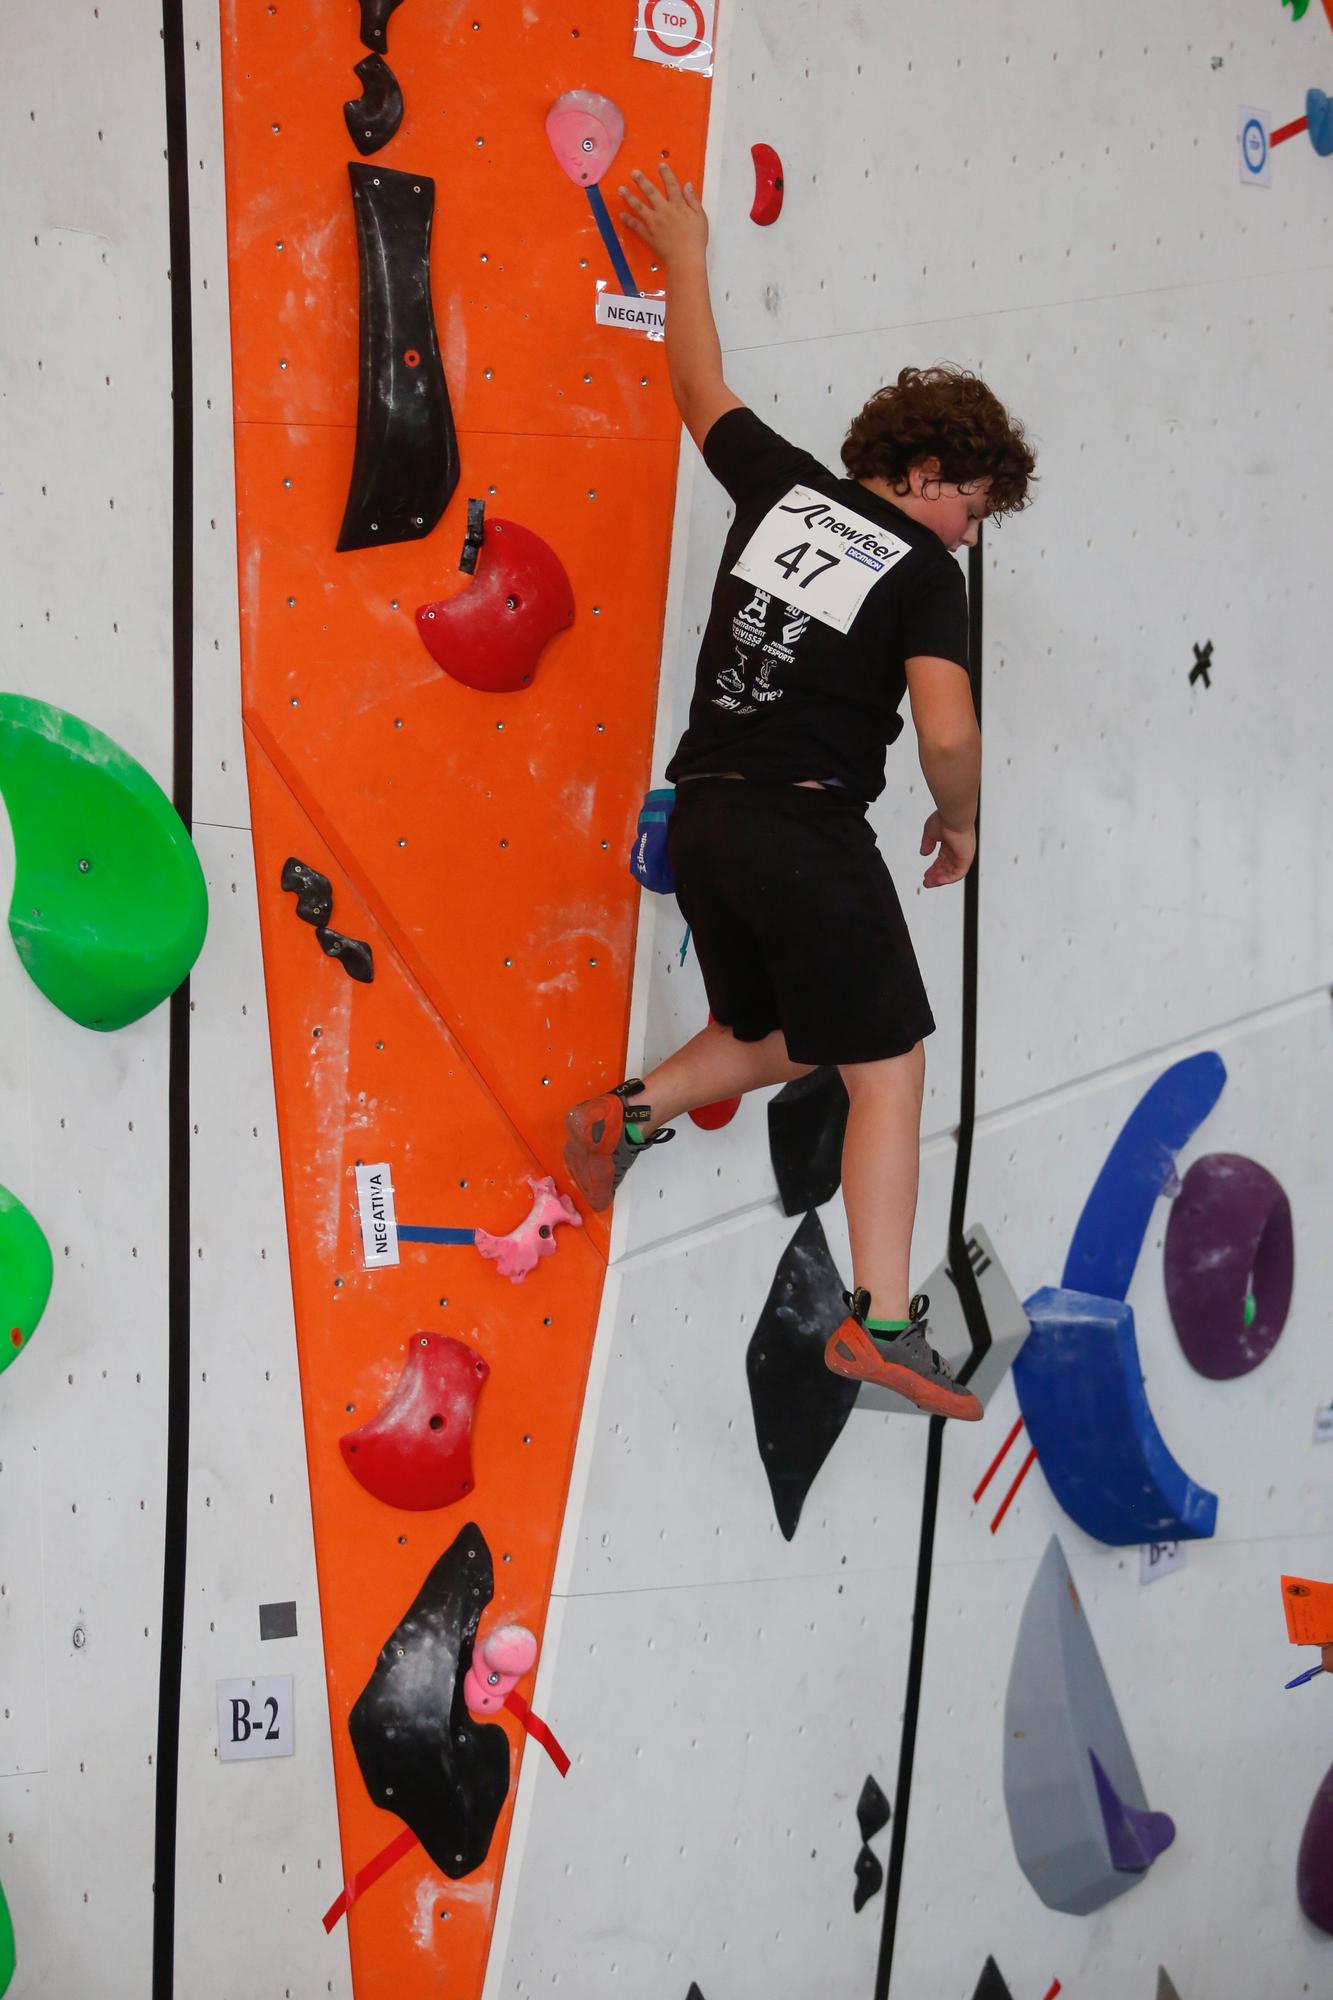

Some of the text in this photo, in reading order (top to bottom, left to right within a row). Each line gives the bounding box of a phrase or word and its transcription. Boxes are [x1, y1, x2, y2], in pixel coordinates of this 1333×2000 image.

[662, 12, 687, 28] TOP
[607, 306, 665, 327] NEGATIV
[817, 515, 900, 561] newfeel
[774, 541, 841, 589] 47
[846, 547, 882, 572] DECATHLON
[761, 644, 796, 664] D'ESPORTS
[770, 640, 794, 655] PATRONAT
[369, 1174, 388, 1253] NEGATIVA
[229, 1696, 280, 1742] B-2
